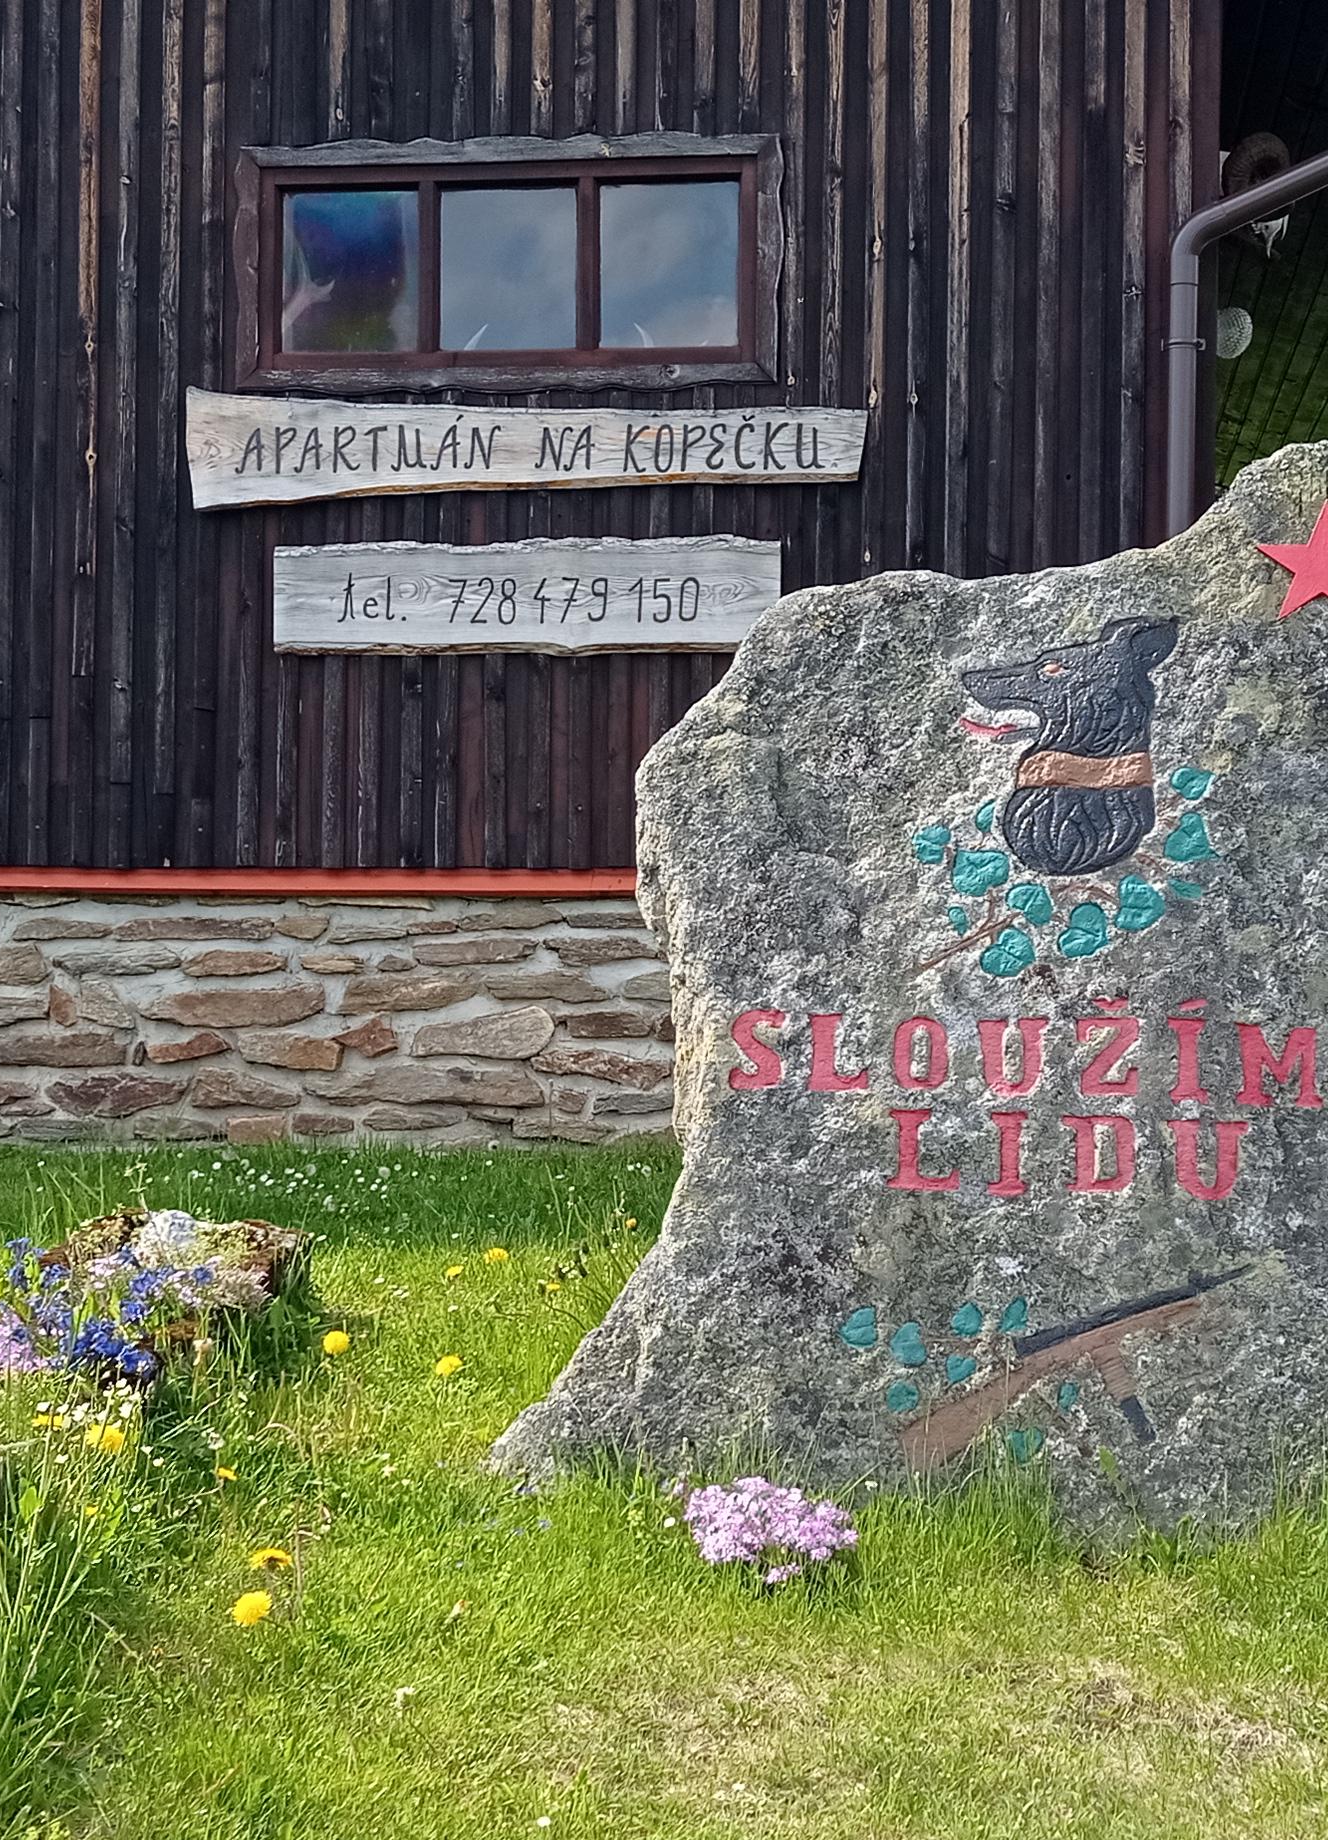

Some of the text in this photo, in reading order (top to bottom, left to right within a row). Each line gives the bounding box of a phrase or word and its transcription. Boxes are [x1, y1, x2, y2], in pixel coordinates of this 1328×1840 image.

[235, 414, 501, 475] APARTMÁN
[534, 424, 596, 472] NA
[448, 577, 518, 625] 728
[532, 577, 609, 624] 479
[627, 577, 701, 623] 150
[887, 1109, 1249, 1201] LIDU
